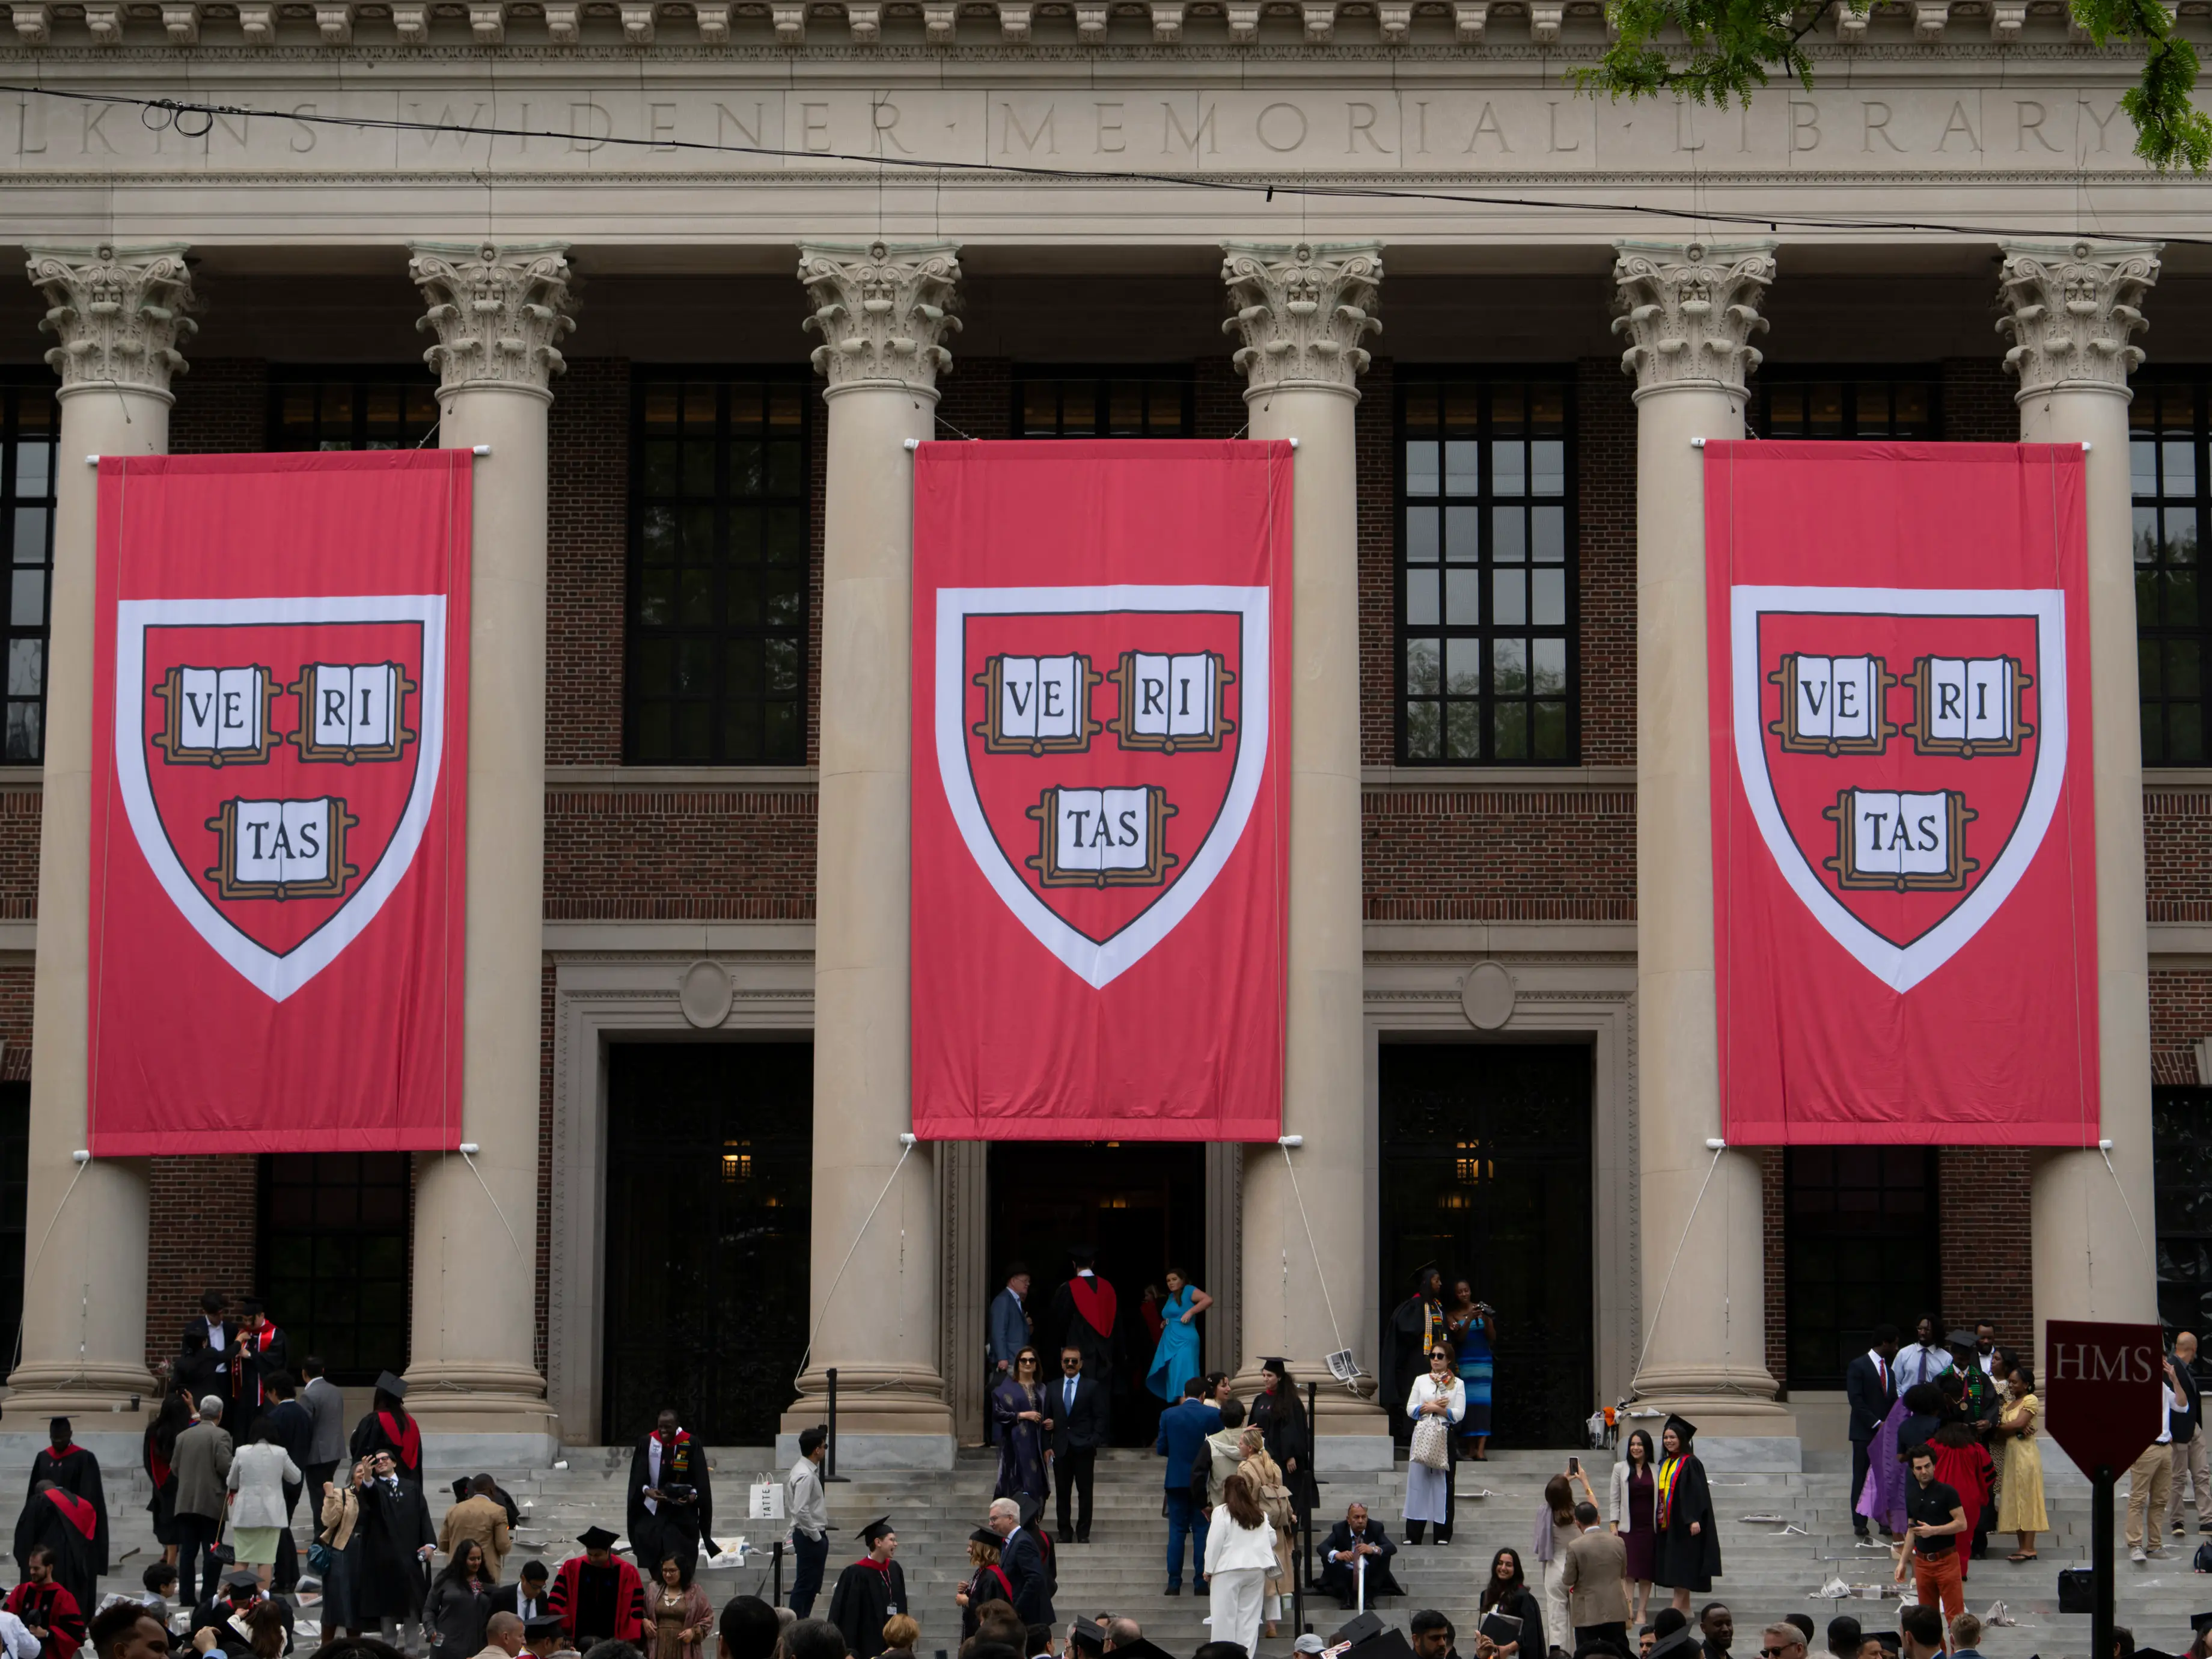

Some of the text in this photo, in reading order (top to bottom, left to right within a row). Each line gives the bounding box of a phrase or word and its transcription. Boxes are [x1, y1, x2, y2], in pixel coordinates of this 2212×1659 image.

[409, 102, 916, 154] WIDENER
[998, 101, 1580, 154] MEMORIAL
[1671, 100, 2124, 153] LIBRARY
[185, 689, 371, 729] VE RI
[1006, 678, 1190, 716] VE RI
[1800, 680, 1987, 720] VE RI
[246, 821, 320, 860] TAS
[1067, 808, 1139, 848] TAS
[1865, 812, 1939, 852] TAS
[2053, 1343, 2152, 1382] HMS
[762, 1488, 771, 1517] TATTE
